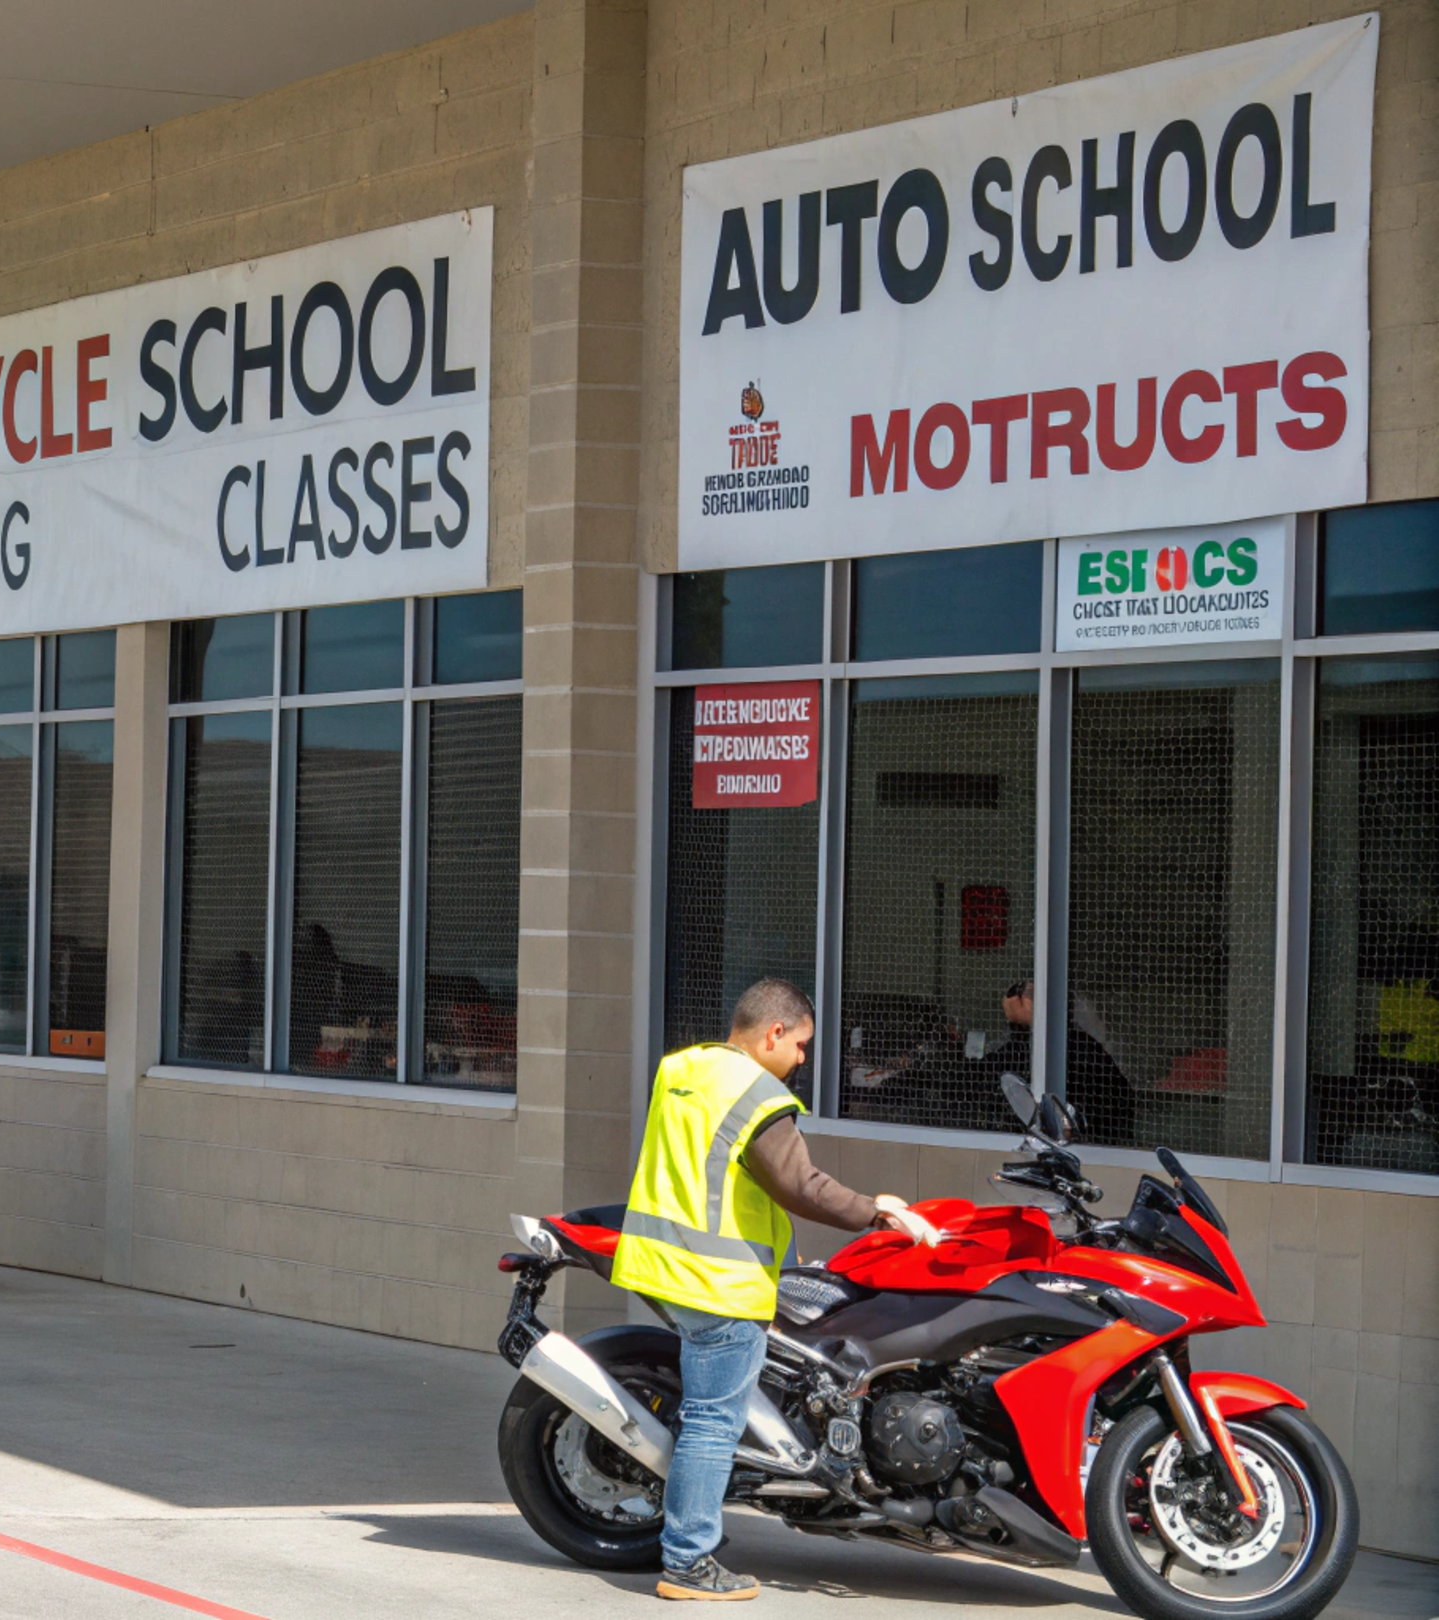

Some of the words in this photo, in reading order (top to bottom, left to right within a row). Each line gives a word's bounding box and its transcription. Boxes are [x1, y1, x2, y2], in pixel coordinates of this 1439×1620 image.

[701, 167, 950, 337] AUTO
[968, 91, 1337, 292] SCHOOL
[138, 256, 477, 443] SCHOOL
[850, 351, 1348, 498] MOTRUCTS
[217, 430, 472, 573] CLASSES
